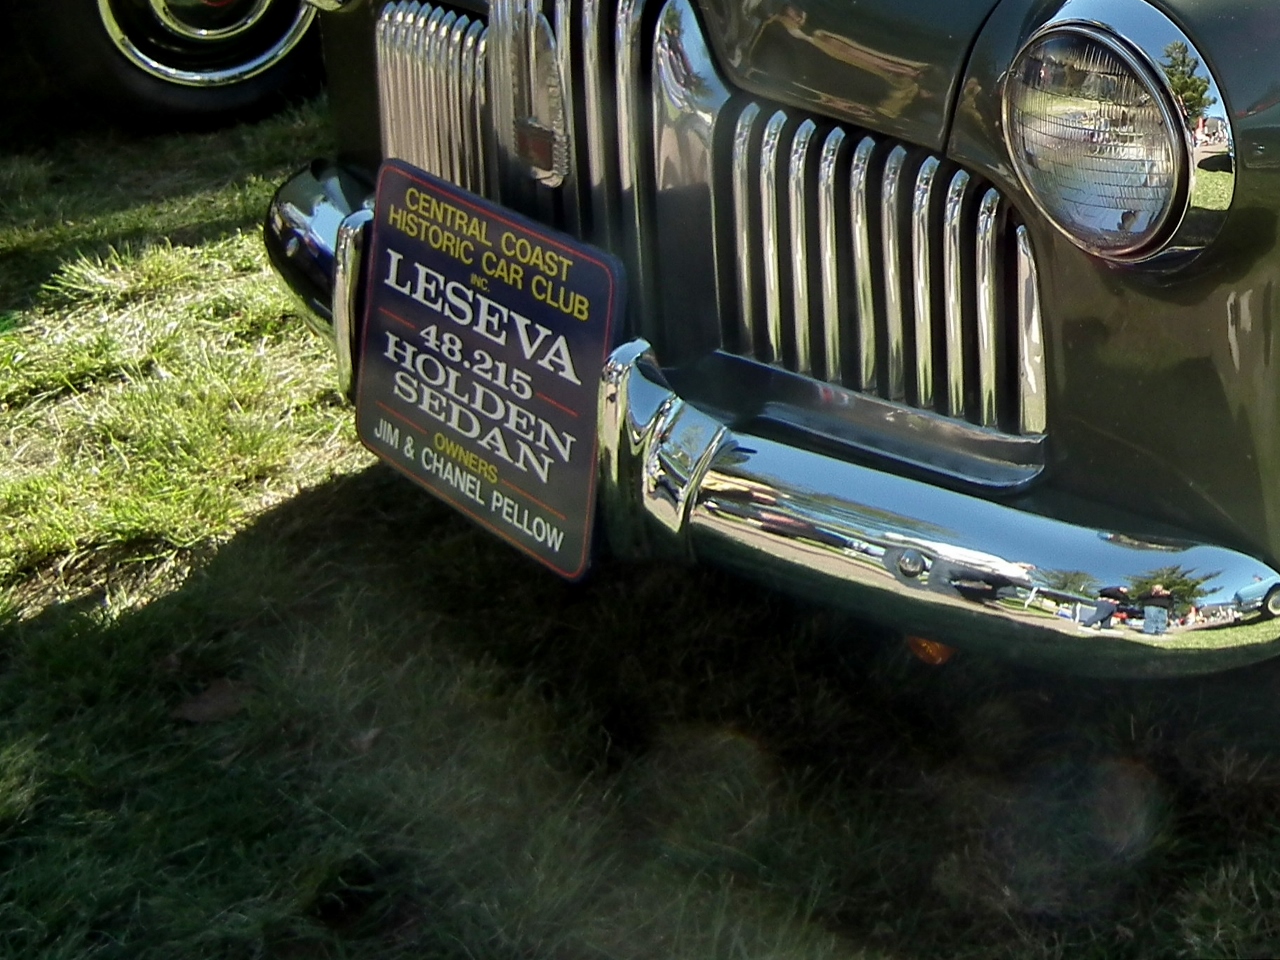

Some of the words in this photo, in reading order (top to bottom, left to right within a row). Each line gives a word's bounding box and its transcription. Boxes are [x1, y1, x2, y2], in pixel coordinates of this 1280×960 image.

[388, 208, 474, 265] HISTORIC
[481, 251, 524, 290] CAR
[530, 274, 590, 321] CLUB
[405, 187, 492, 248] CENTRAL
[501, 230, 573, 282] COAST
[470, 272, 490, 293] INC.
[383, 248, 582, 386] LESEVA
[418, 323, 534, 401] 48.215
[383, 331, 577, 463] HOLDEN
[393, 370, 554, 485] SEDAN
[373, 418, 400, 451] JIM
[403, 438, 416, 462] &
[421, 448, 485, 507] CHANEL
[491, 493, 565, 553] PELLOW
[433, 431, 499, 484] OWNERS
